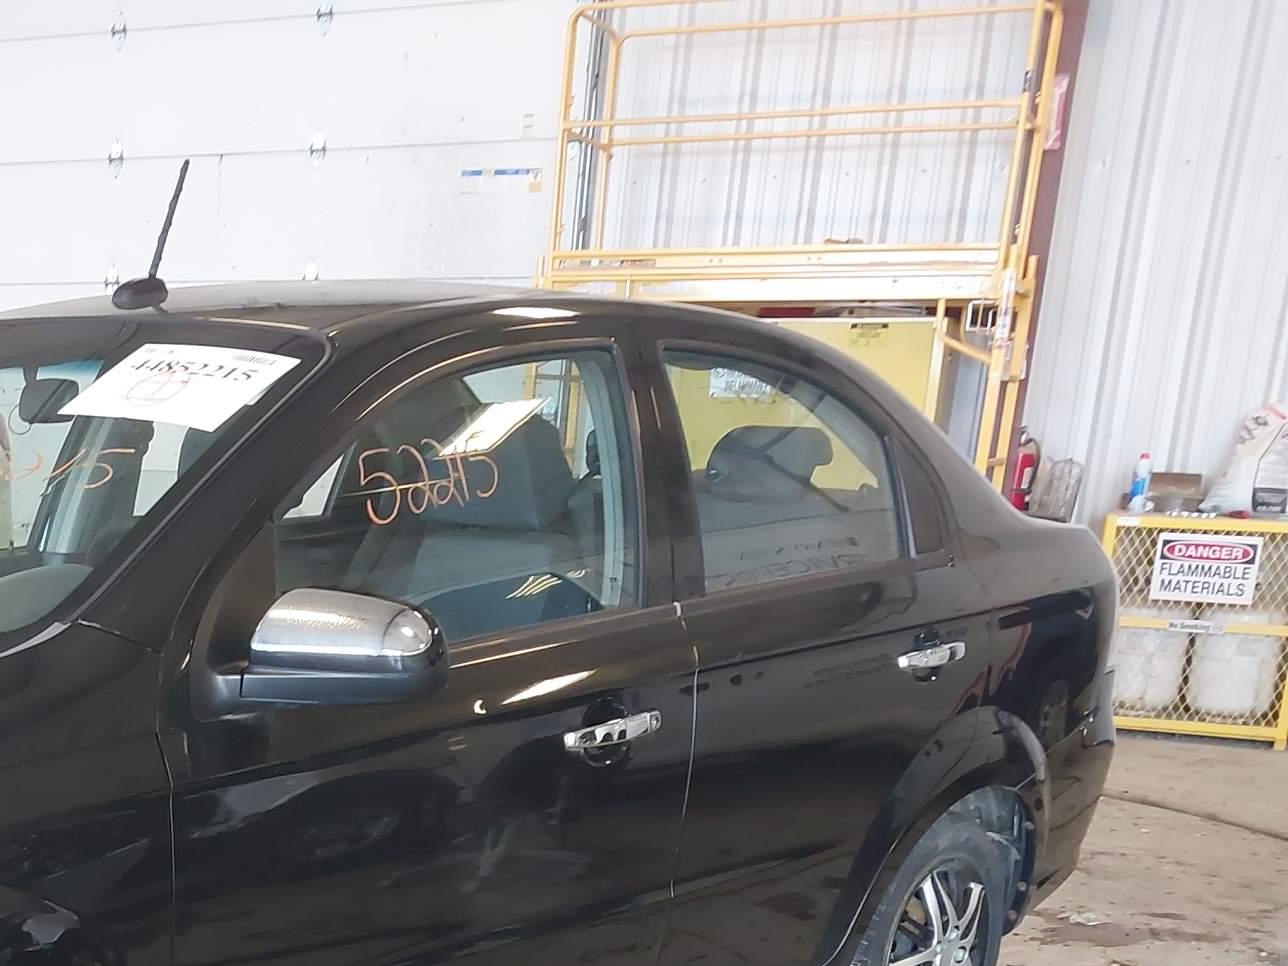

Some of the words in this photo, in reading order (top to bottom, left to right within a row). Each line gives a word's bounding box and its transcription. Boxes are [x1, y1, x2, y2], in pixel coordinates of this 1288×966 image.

[132, 359, 259, 382] 44852215
[358, 438, 498, 525] 52215
[1173, 544, 1244, 560] DANGER
[1159, 562, 1252, 580] FLAMMABLE
[1159, 579, 1245, 597] MATERIALS
